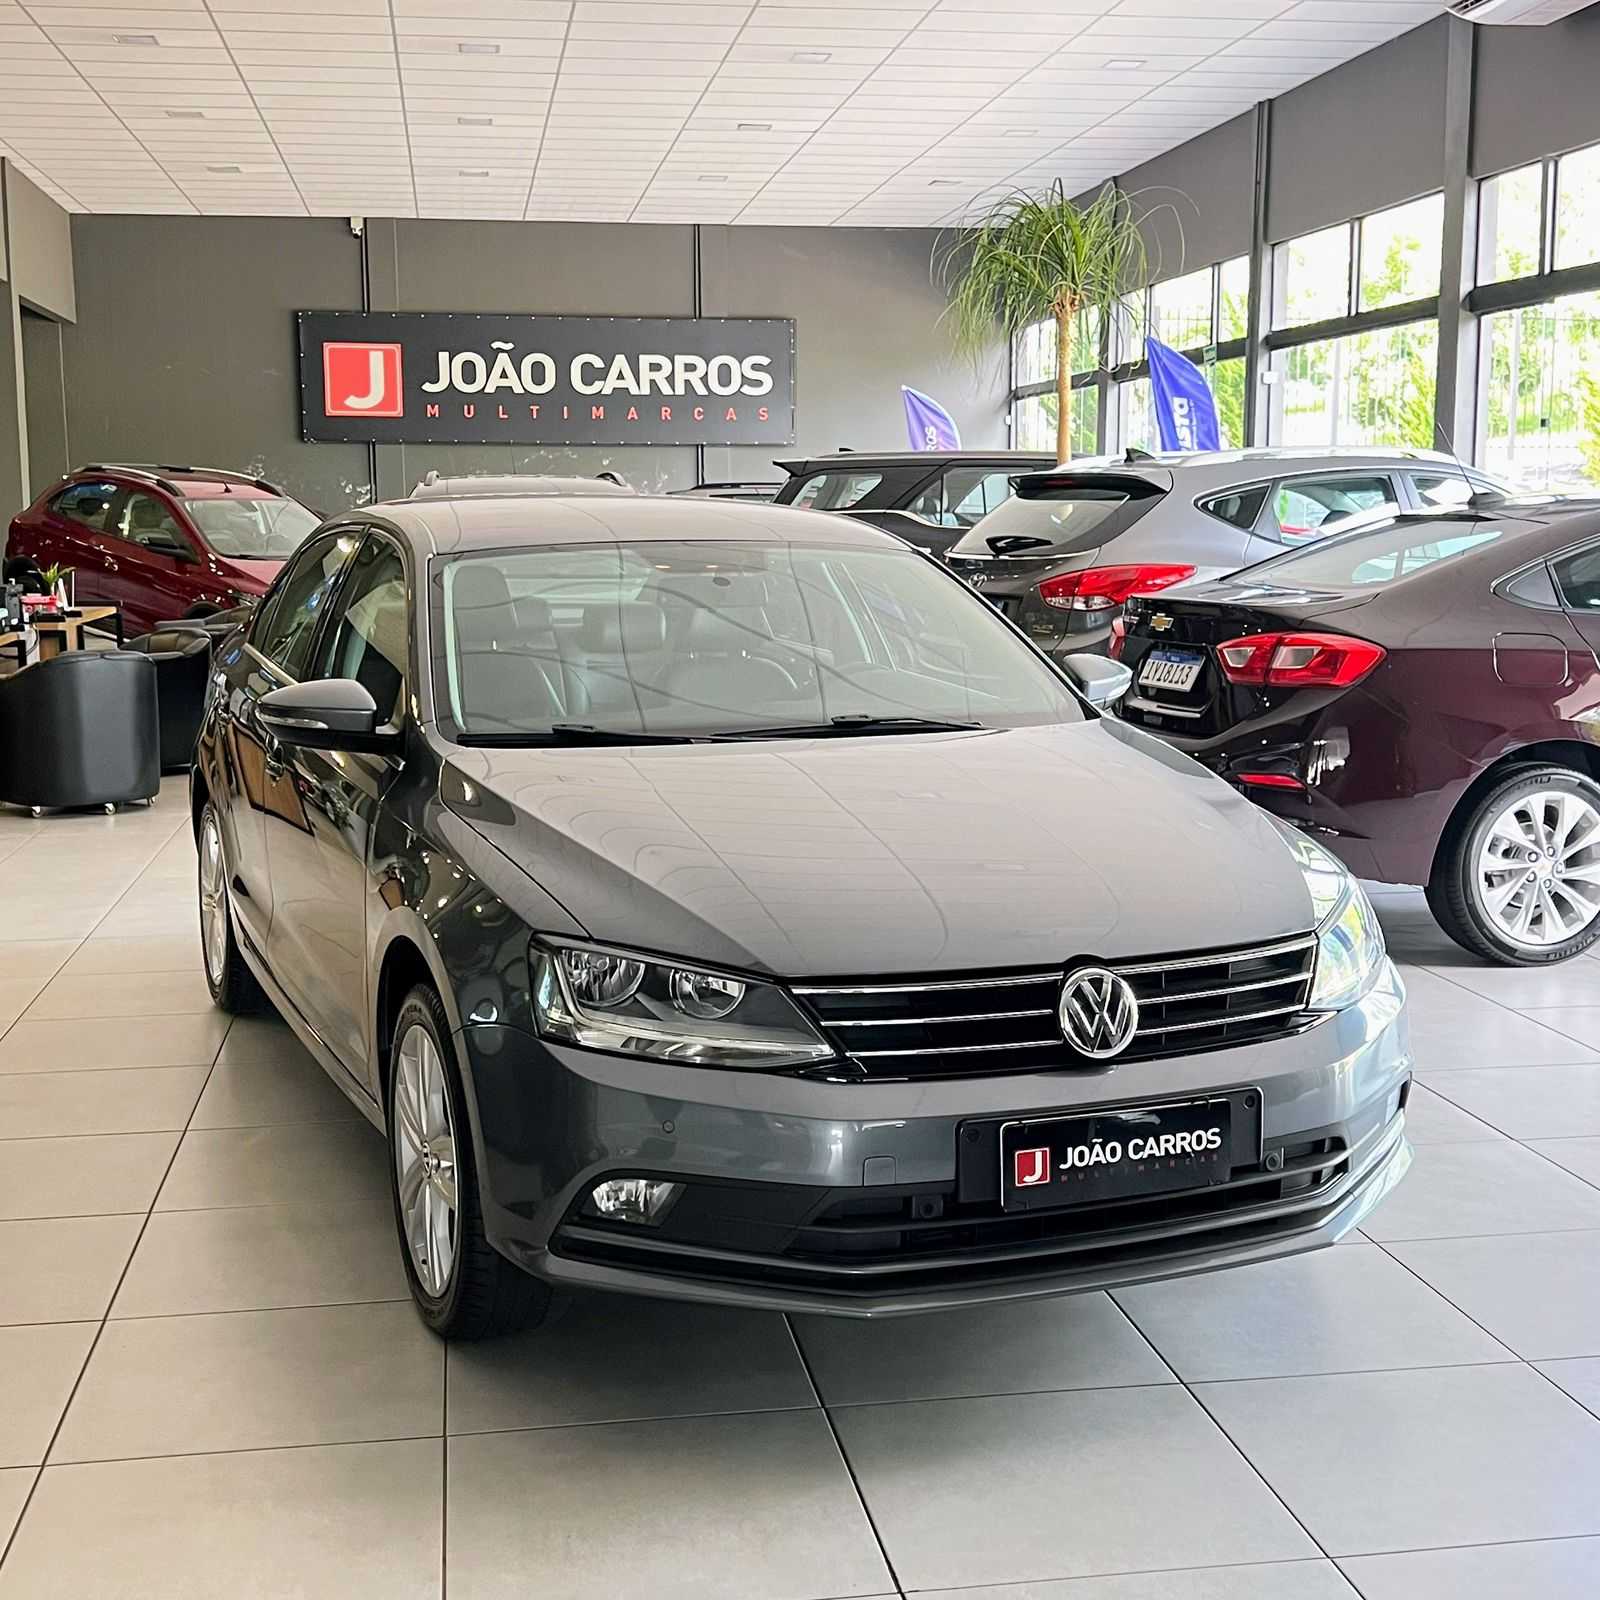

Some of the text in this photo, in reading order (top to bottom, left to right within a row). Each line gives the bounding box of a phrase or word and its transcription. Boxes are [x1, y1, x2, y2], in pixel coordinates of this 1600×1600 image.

[344, 350, 385, 408] J
[420, 341, 773, 396] JOÃO CARROS
[426, 404, 769, 421] MULTIMARCAS
[1023, 1151, 1043, 1183] J
[1059, 1127, 1221, 1169] JOÃO CARROS
